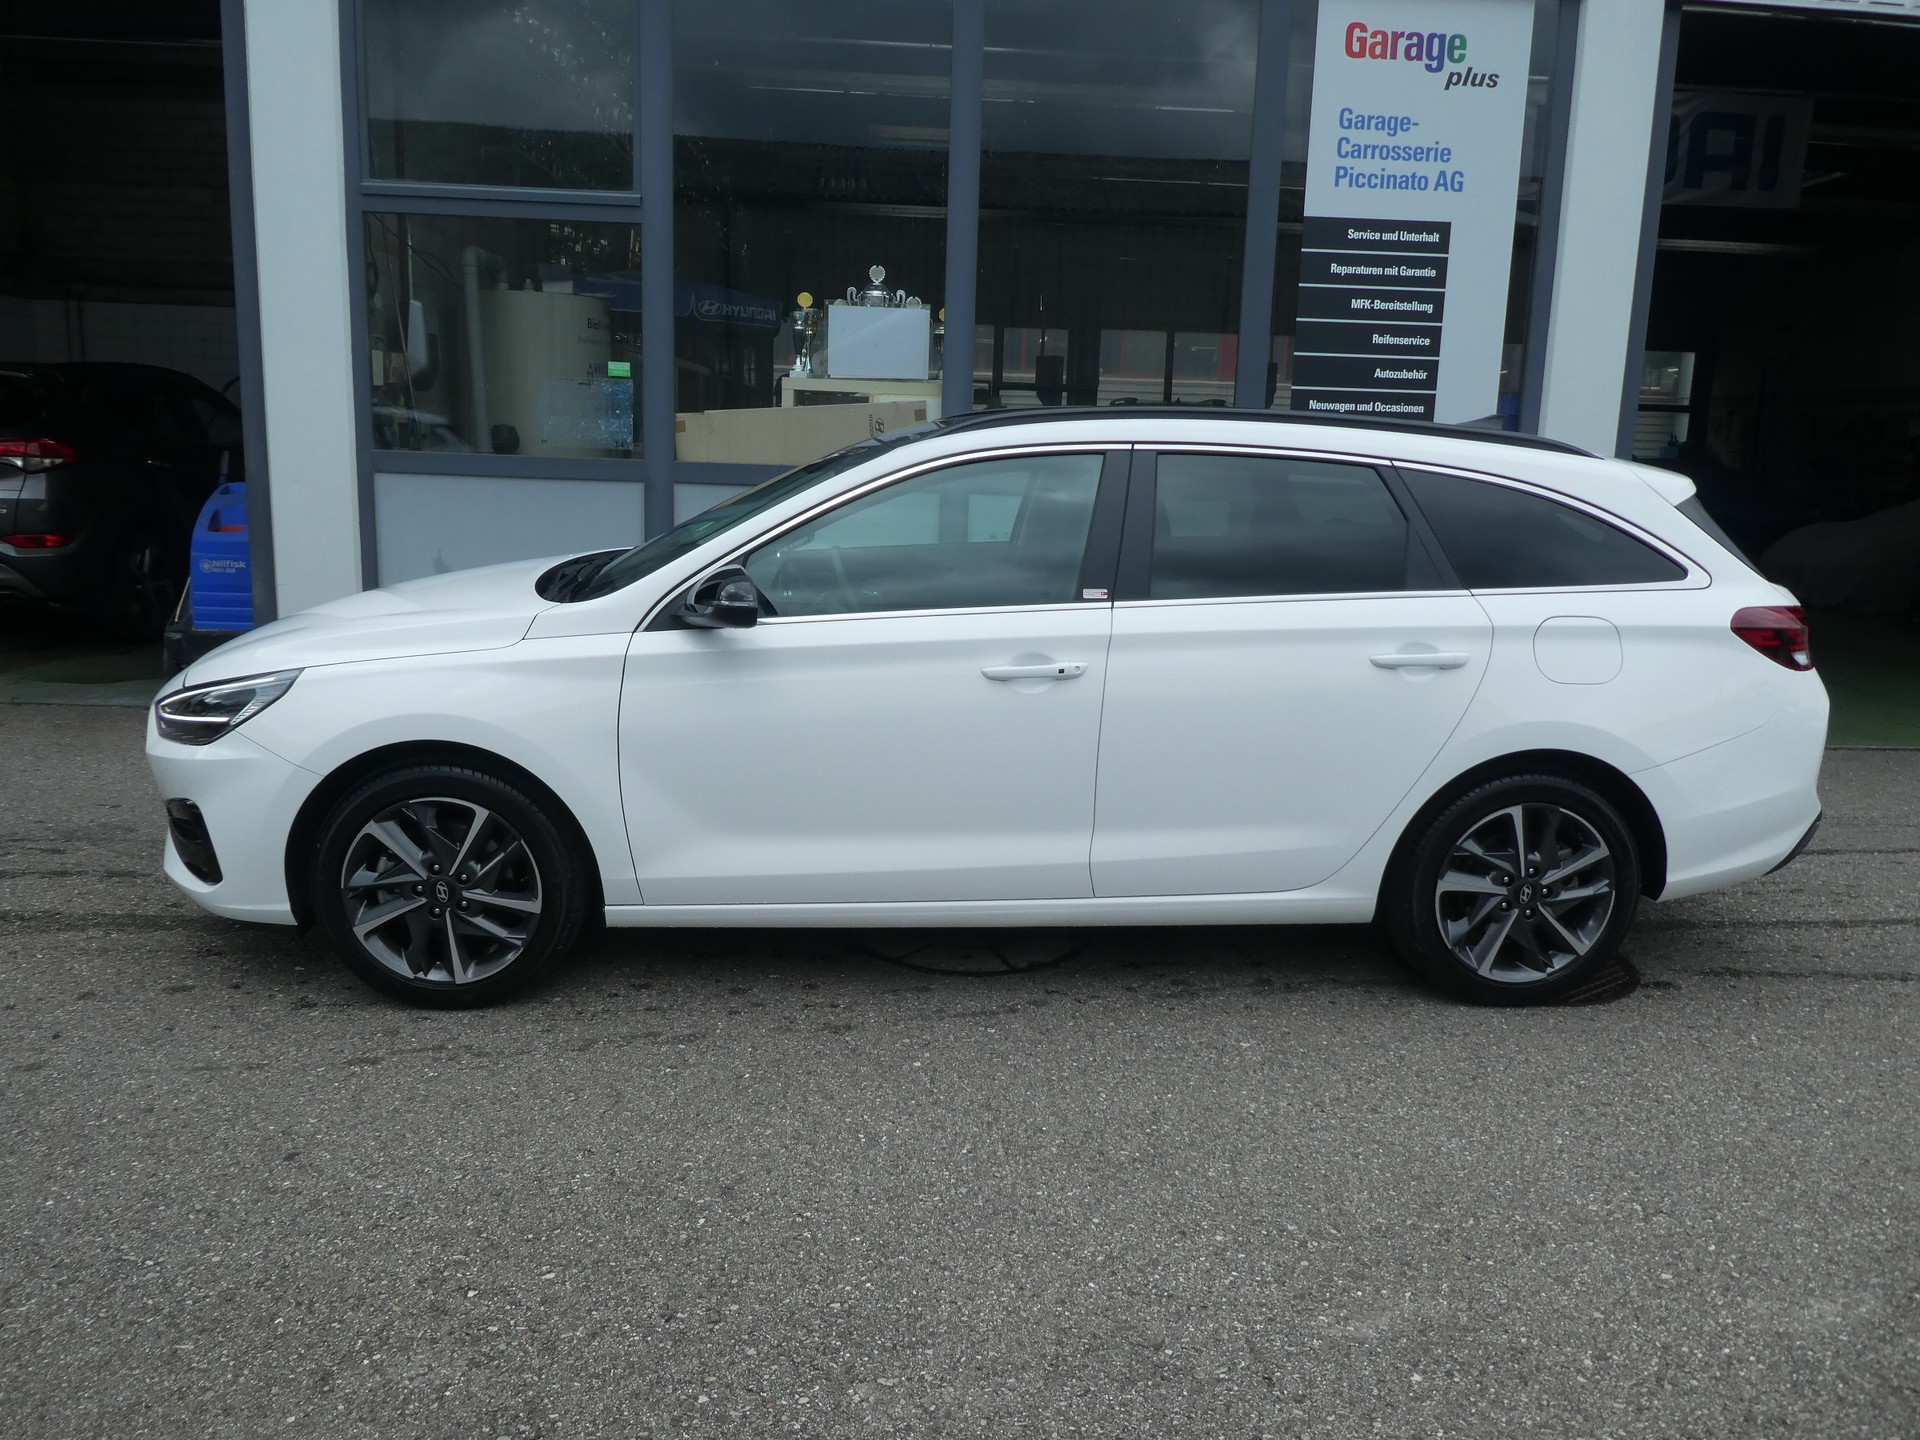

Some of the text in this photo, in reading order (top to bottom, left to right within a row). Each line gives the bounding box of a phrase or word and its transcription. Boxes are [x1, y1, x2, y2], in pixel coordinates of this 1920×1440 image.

[1344, 21, 1467, 73] Garage
[1444, 67, 1500, 90] plus
[1339, 107, 1419, 136] Garage-
[1337, 136, 1452, 163] Carrosserie
[1663, 111, 1786, 191] AI
[1334, 166, 1465, 192] Piccinato AG
[1347, 229, 1440, 243] Service und Unterhalt
[1330, 263, 1436, 277] Reparaturen mit Garantie
[722, 303, 777, 322] HYUNDAI
[1351, 299, 1433, 313] MFK-Bereitstellung
[1372, 334, 1430, 346] Reifenservice
[1374, 368, 1427, 380] Autozubehör
[1309, 400, 1424, 414] Neuwagen und Occasionen
[212, 559, 247, 568] Nilfisk
